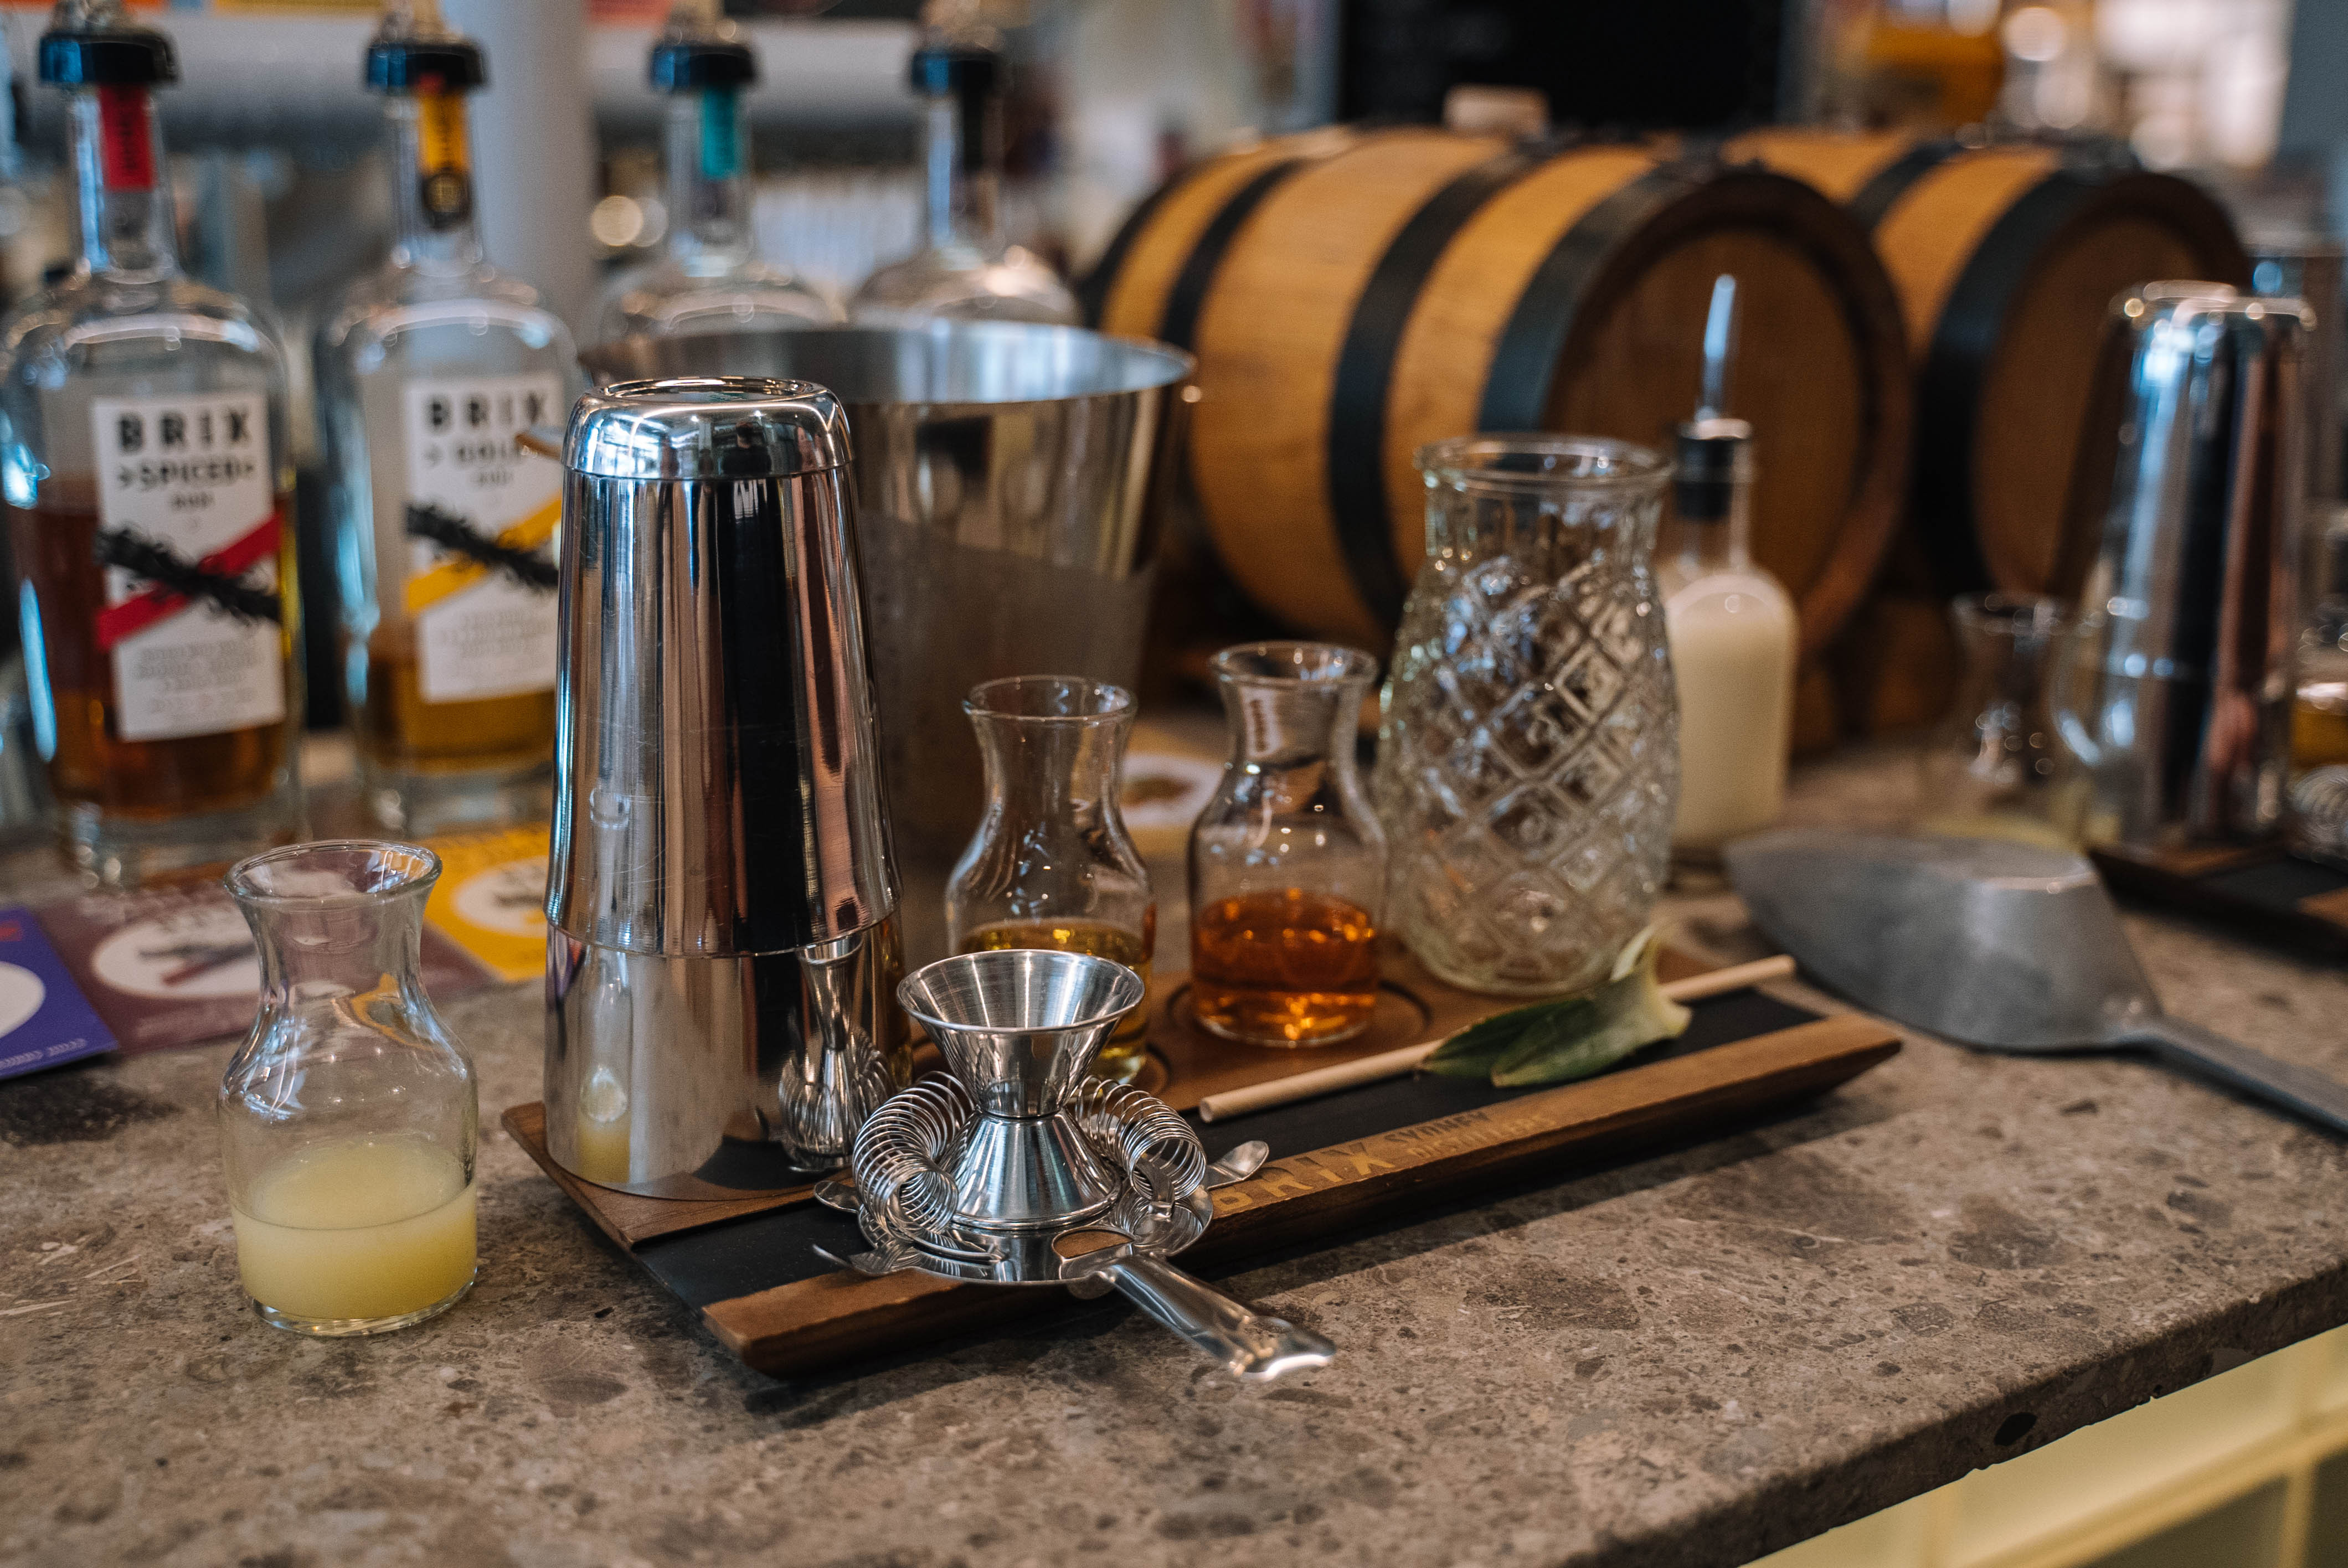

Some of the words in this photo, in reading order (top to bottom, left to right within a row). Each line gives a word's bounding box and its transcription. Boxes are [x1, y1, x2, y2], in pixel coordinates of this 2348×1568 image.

[117, 408, 250, 451] BRIX
[425, 391, 548, 432] BRIX
[1384, 1111, 1490, 1144] SYDNEY
[1211, 1142, 1396, 1211] BRIX
